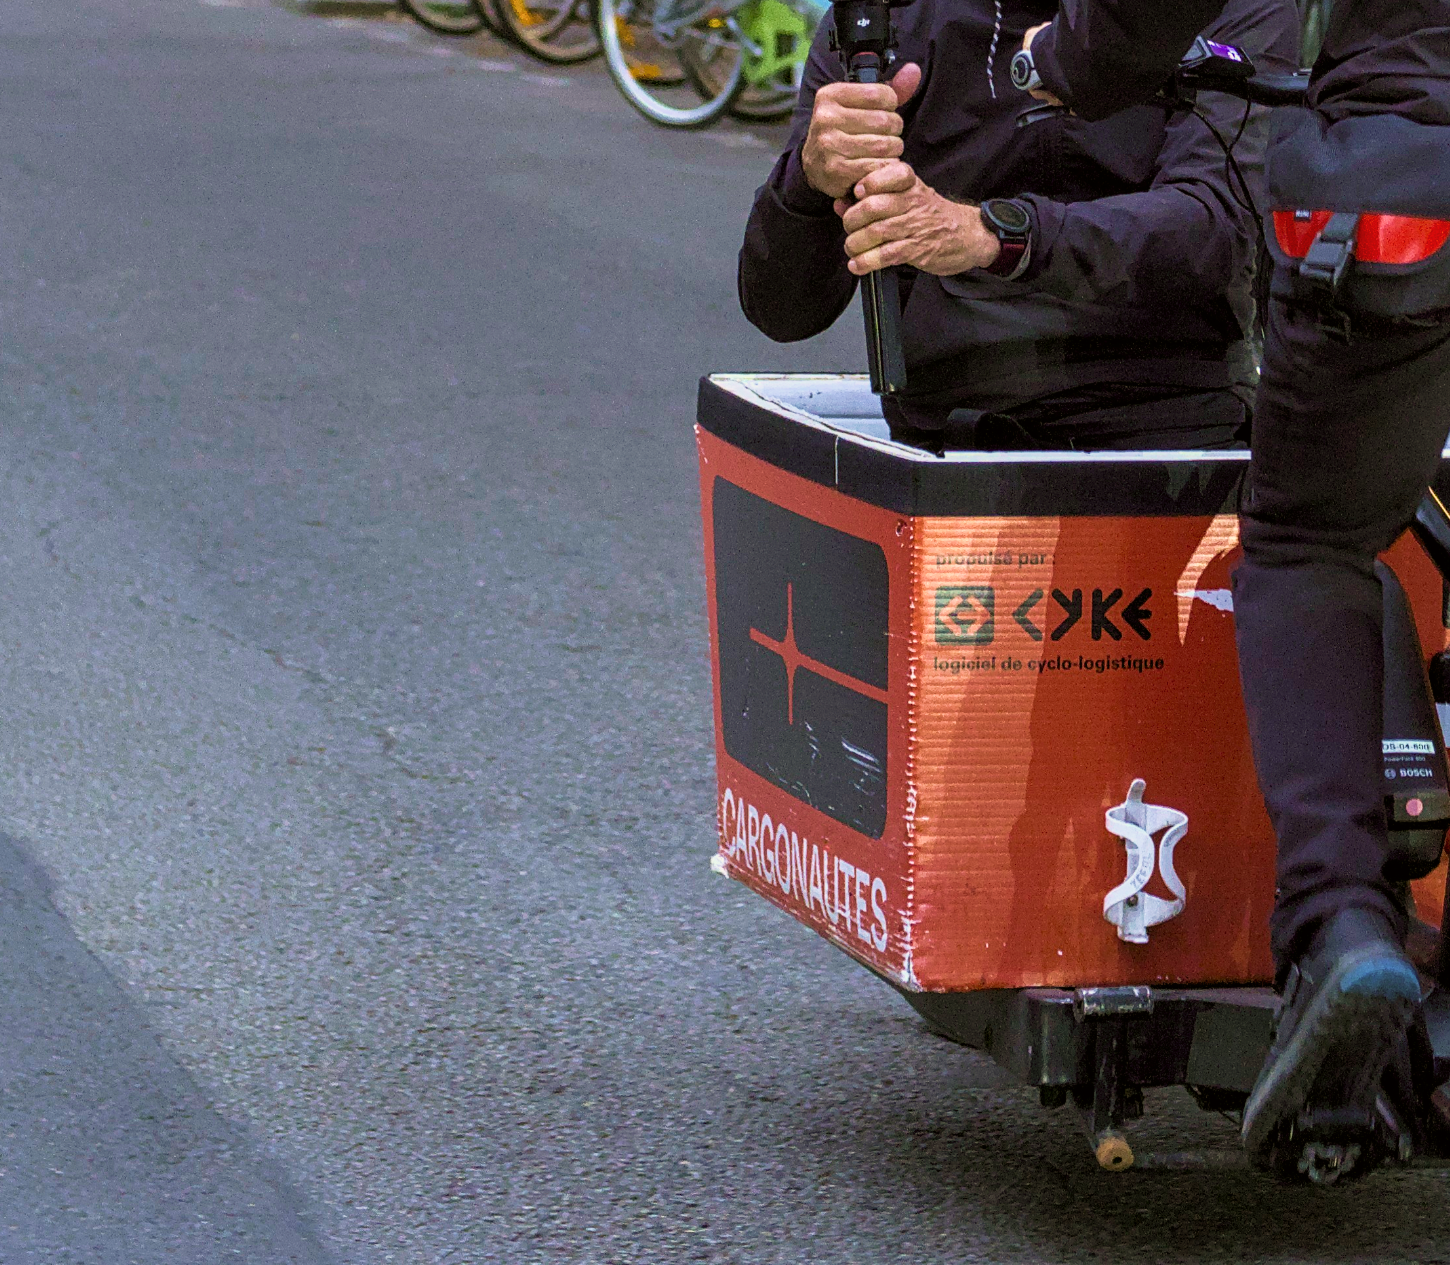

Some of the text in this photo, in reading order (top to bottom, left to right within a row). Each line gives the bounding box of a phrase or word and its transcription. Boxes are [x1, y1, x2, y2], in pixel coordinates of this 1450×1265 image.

[936, 551, 1013, 568] propulsé
[1018, 553, 1045, 568] par
[933, 655, 1165, 674] logiciel de cyclo-logistique
[1399, 768, 1433, 777] BOSCH
[723, 788, 888, 953] CARGONAUTES
